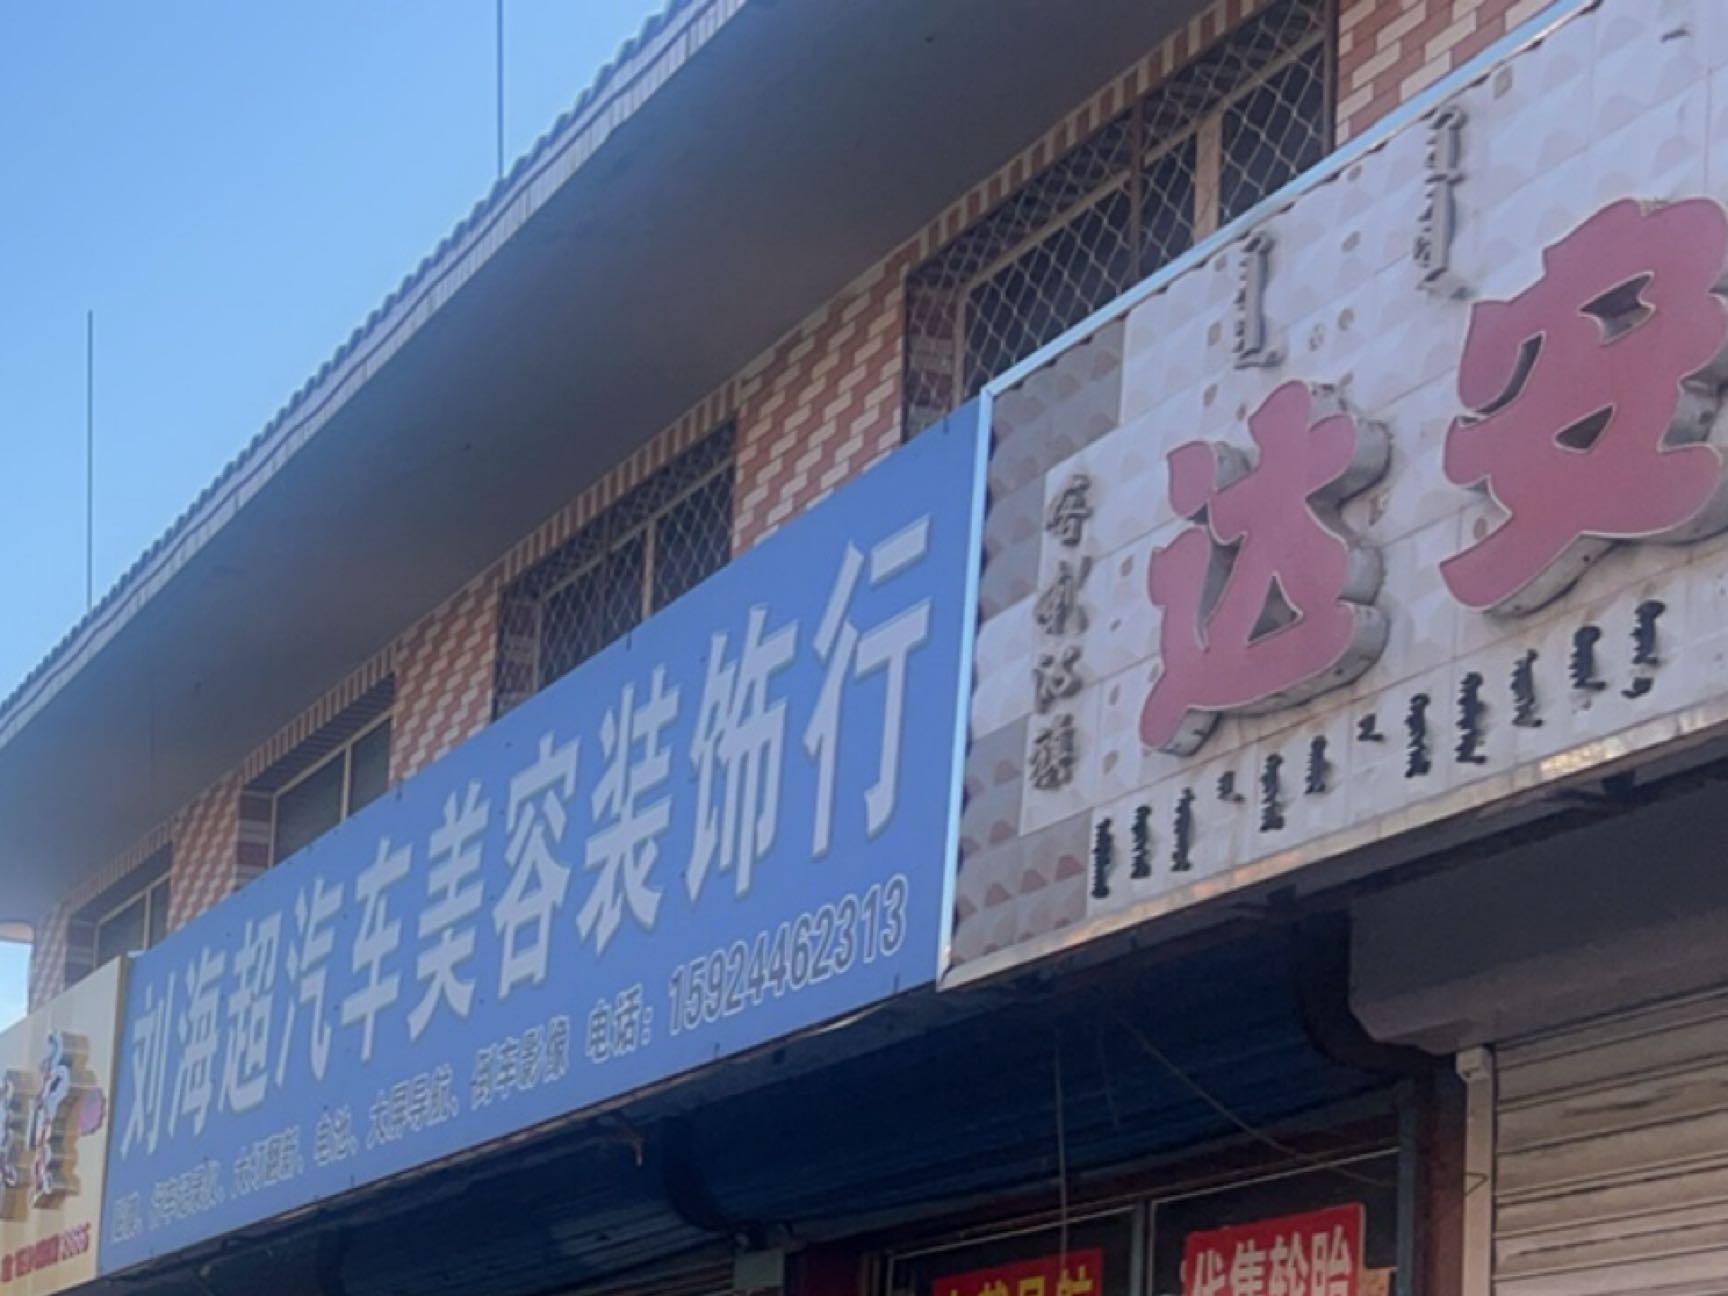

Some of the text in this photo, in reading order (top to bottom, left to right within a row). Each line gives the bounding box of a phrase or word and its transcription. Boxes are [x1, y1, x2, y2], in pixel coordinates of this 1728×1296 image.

[120, 514, 932, 1160] 刘海超汽车美容装饰行
